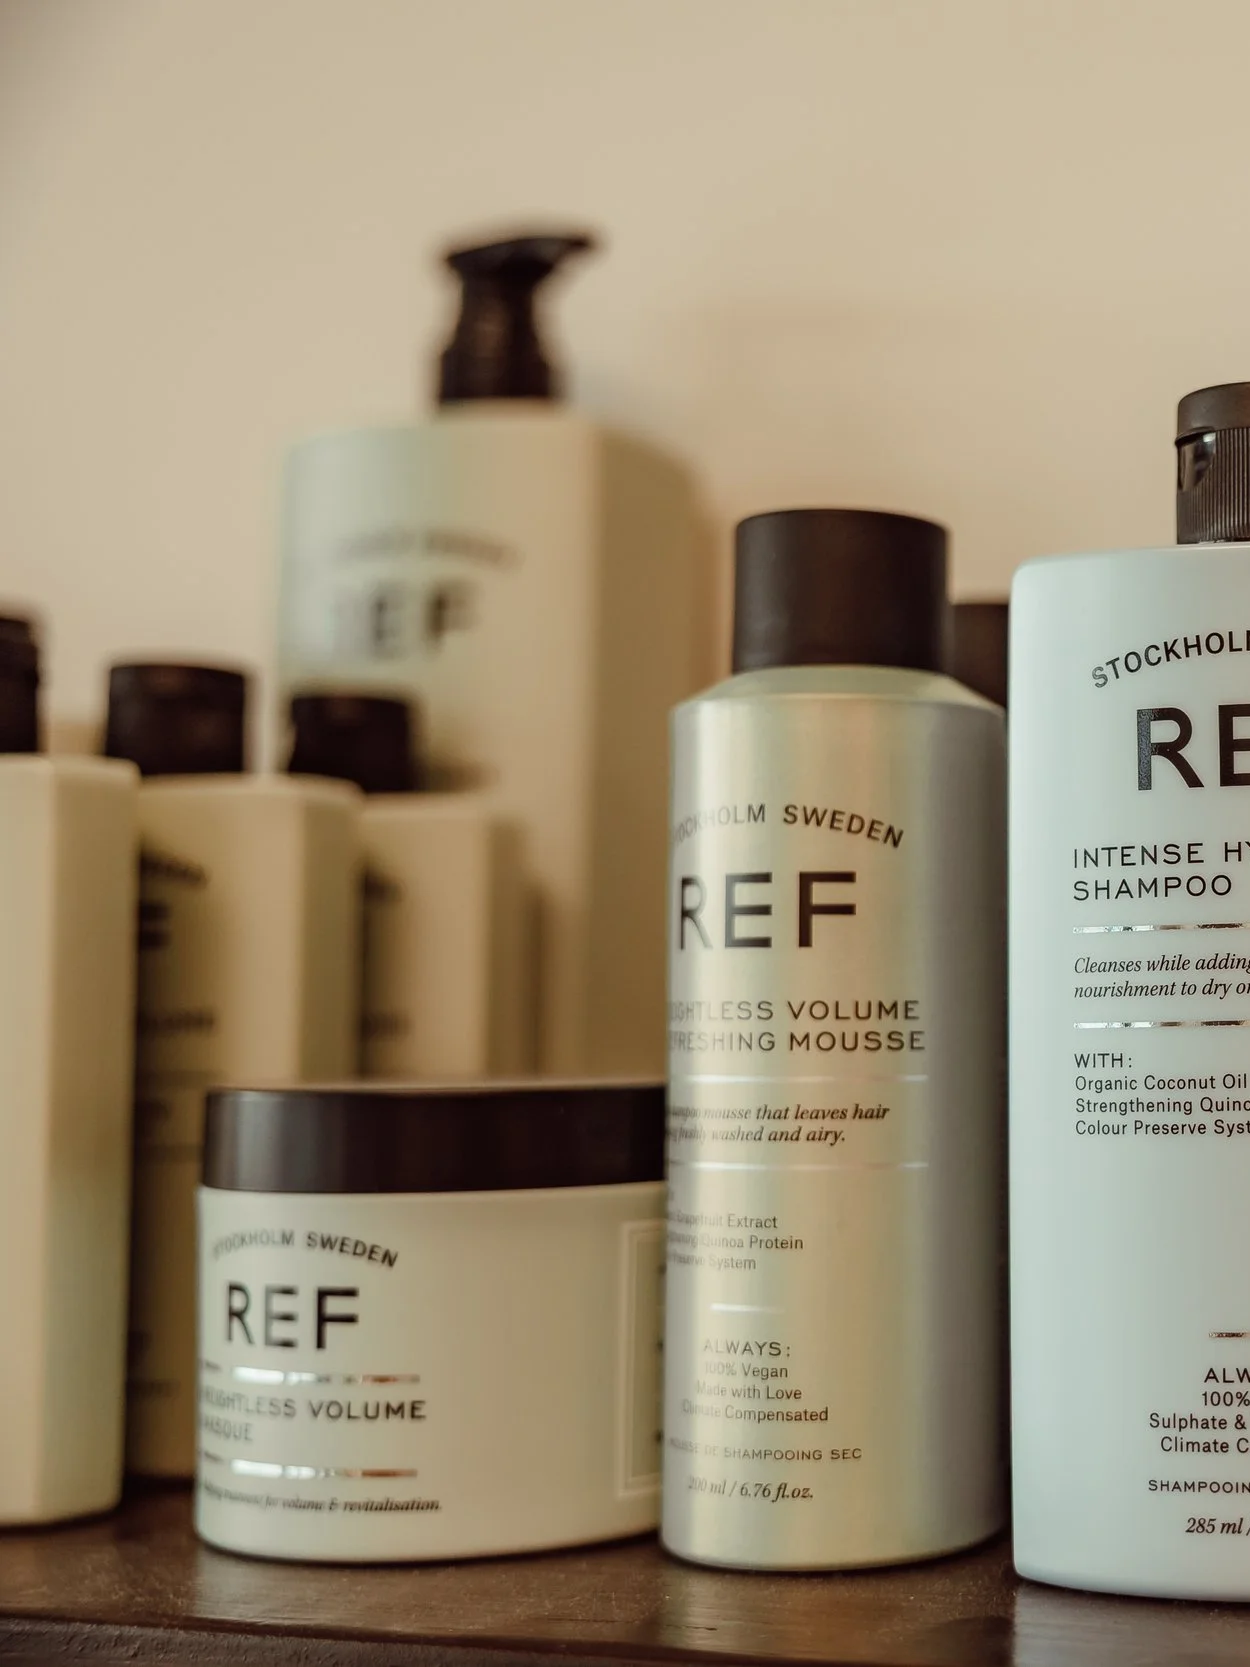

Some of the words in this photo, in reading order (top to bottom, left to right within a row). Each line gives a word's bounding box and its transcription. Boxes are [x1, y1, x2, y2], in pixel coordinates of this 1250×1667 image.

[673, 804, 766, 844] OCKHOLM
[783, 804, 904, 848] SWEDEN
[1074, 842, 1205, 869] INTENSE
[1073, 874, 1232, 902] SHAMPOO
[680, 871, 857, 950] REF
[1074, 956, 1142, 974] Cleanses
[1146, 953, 1191, 972] while
[1074, 980, 1177, 998] nourishment
[1180, 981, 1198, 996] to
[1201, 977, 1233, 1001] dry
[786, 999, 919, 1021] VOLUME
[789, 1030, 925, 1053] MOUSSE
[1073, 1052, 1132, 1069] WITH:
[1075, 1075, 1138, 1094] Organic
[1143, 1074, 1217, 1091] Coconut
[1222, 1072, 1247, 1090] Oil
[756, 1105, 790, 1120] that
[793, 1103, 849, 1121] leaves
[851, 1103, 891, 1121] hair
[1075, 1096, 1193, 1117] Strengthening
[767, 1125, 803, 1143] and
[805, 1126, 846, 1148] airy.
[1075, 1119, 1128, 1136] Colour
[1134, 1119, 1207, 1136] Preserve
[727, 1213, 779, 1230] Extract
[306, 1231, 399, 1268] SWEDEN
[749, 1234, 804, 1250] Protein
[708, 1256, 757, 1271] System
[226, 1282, 360, 1350] REF
[704, 1338, 791, 1358] ALWAYS:
[704, 1361, 736, 1376] 100%
[741, 1362, 789, 1381] Vegan
[732, 1385, 761, 1399] with
[765, 1384, 803, 1401] Love
[1201, 1390, 1250, 1408] 100%
[309, 1400, 427, 1421] VOLUME
[725, 1405, 829, 1425] Compensated
[1149, 1412, 1228, 1433] Sulphate
[1233, 1413, 1248, 1431] &
[724, 1447, 823, 1461] SHAMPOOING
[830, 1447, 862, 1461] SEC
[1160, 1435, 1230, 1454] Climate
[740, 1483, 771, 1498] 6.76
[771, 1483, 814, 1503] fl.oz.
[1184, 1516, 1217, 1534] 285
[1219, 1517, 1244, 1535] ml
